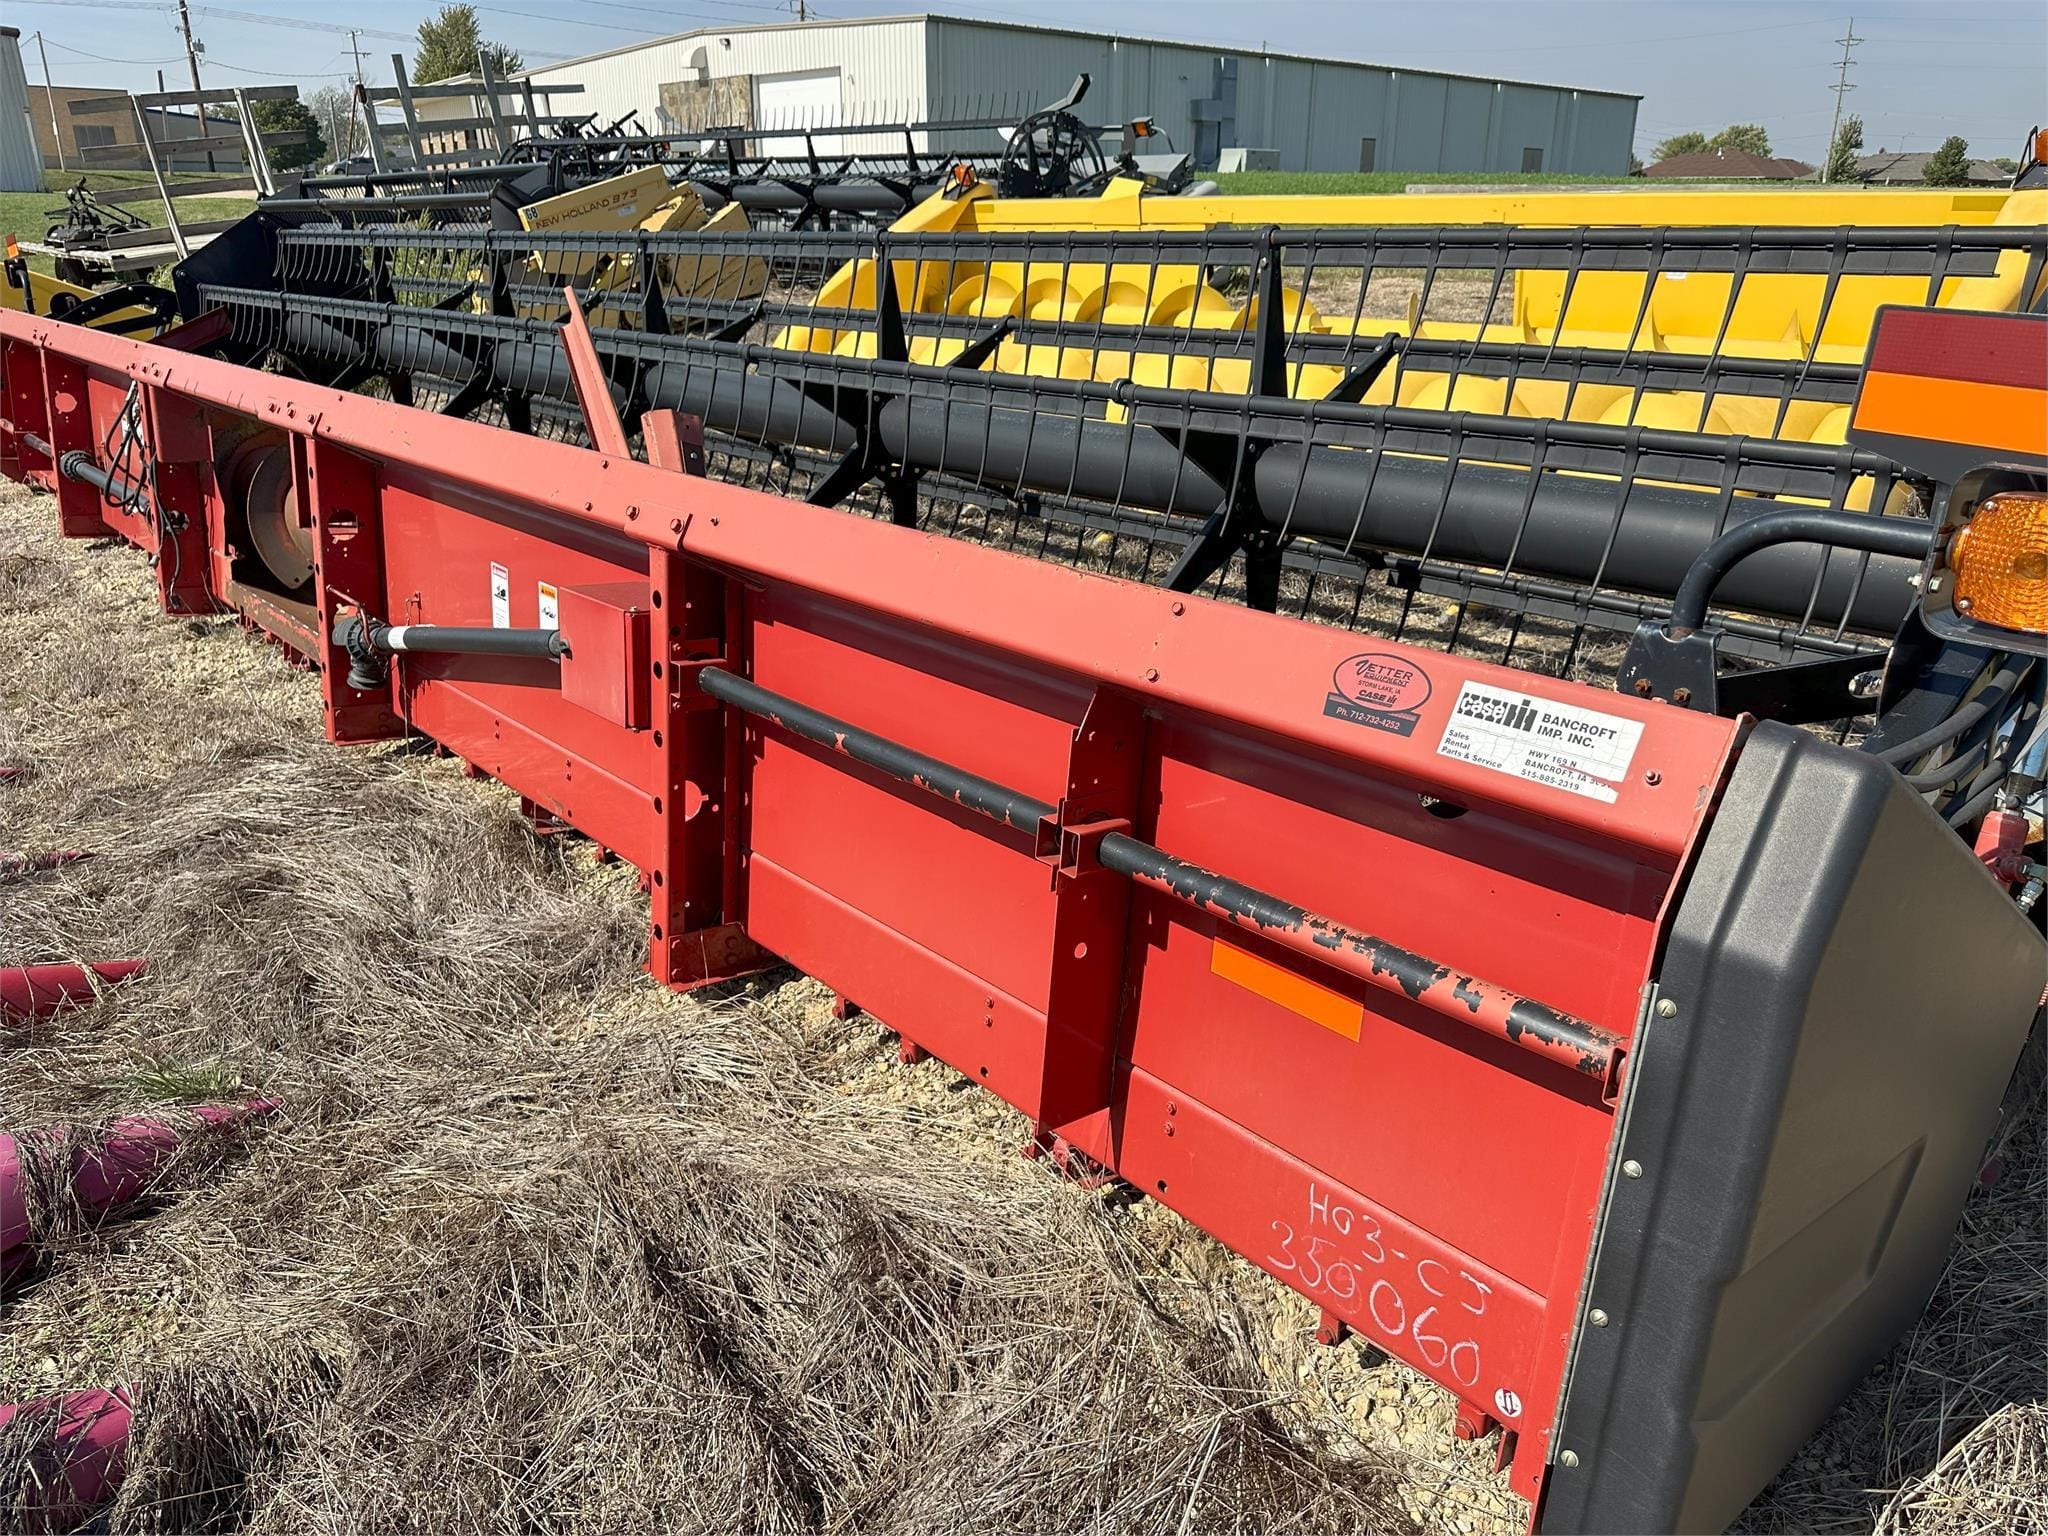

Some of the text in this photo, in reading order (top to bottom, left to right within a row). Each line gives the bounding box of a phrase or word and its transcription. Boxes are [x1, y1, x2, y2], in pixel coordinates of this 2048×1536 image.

[535, 216, 560, 229] NEW
[562, 199, 610, 221] HOLLAND
[1355, 660, 1413, 681] VETTER
[1363, 671, 1409, 687] EQUIPMENT
[1358, 680, 1377, 689] STORM
[1358, 689, 1387, 703] CASE
[1336, 707, 1400, 730] Ph. 712-732-4252
[1541, 713, 1618, 740] BANCROFT
[1445, 738, 1471, 750] Rental
[1448, 729, 1470, 741] Sales
[1537, 725, 1595, 749] IMP. INC.
[1441, 746, 1503, 769] Parts & Service
[1528, 749, 1577, 768] HWY 169 N
[1521, 768, 1580, 791] 515-885-2319
[1577, 774, 1587, 782] IA
